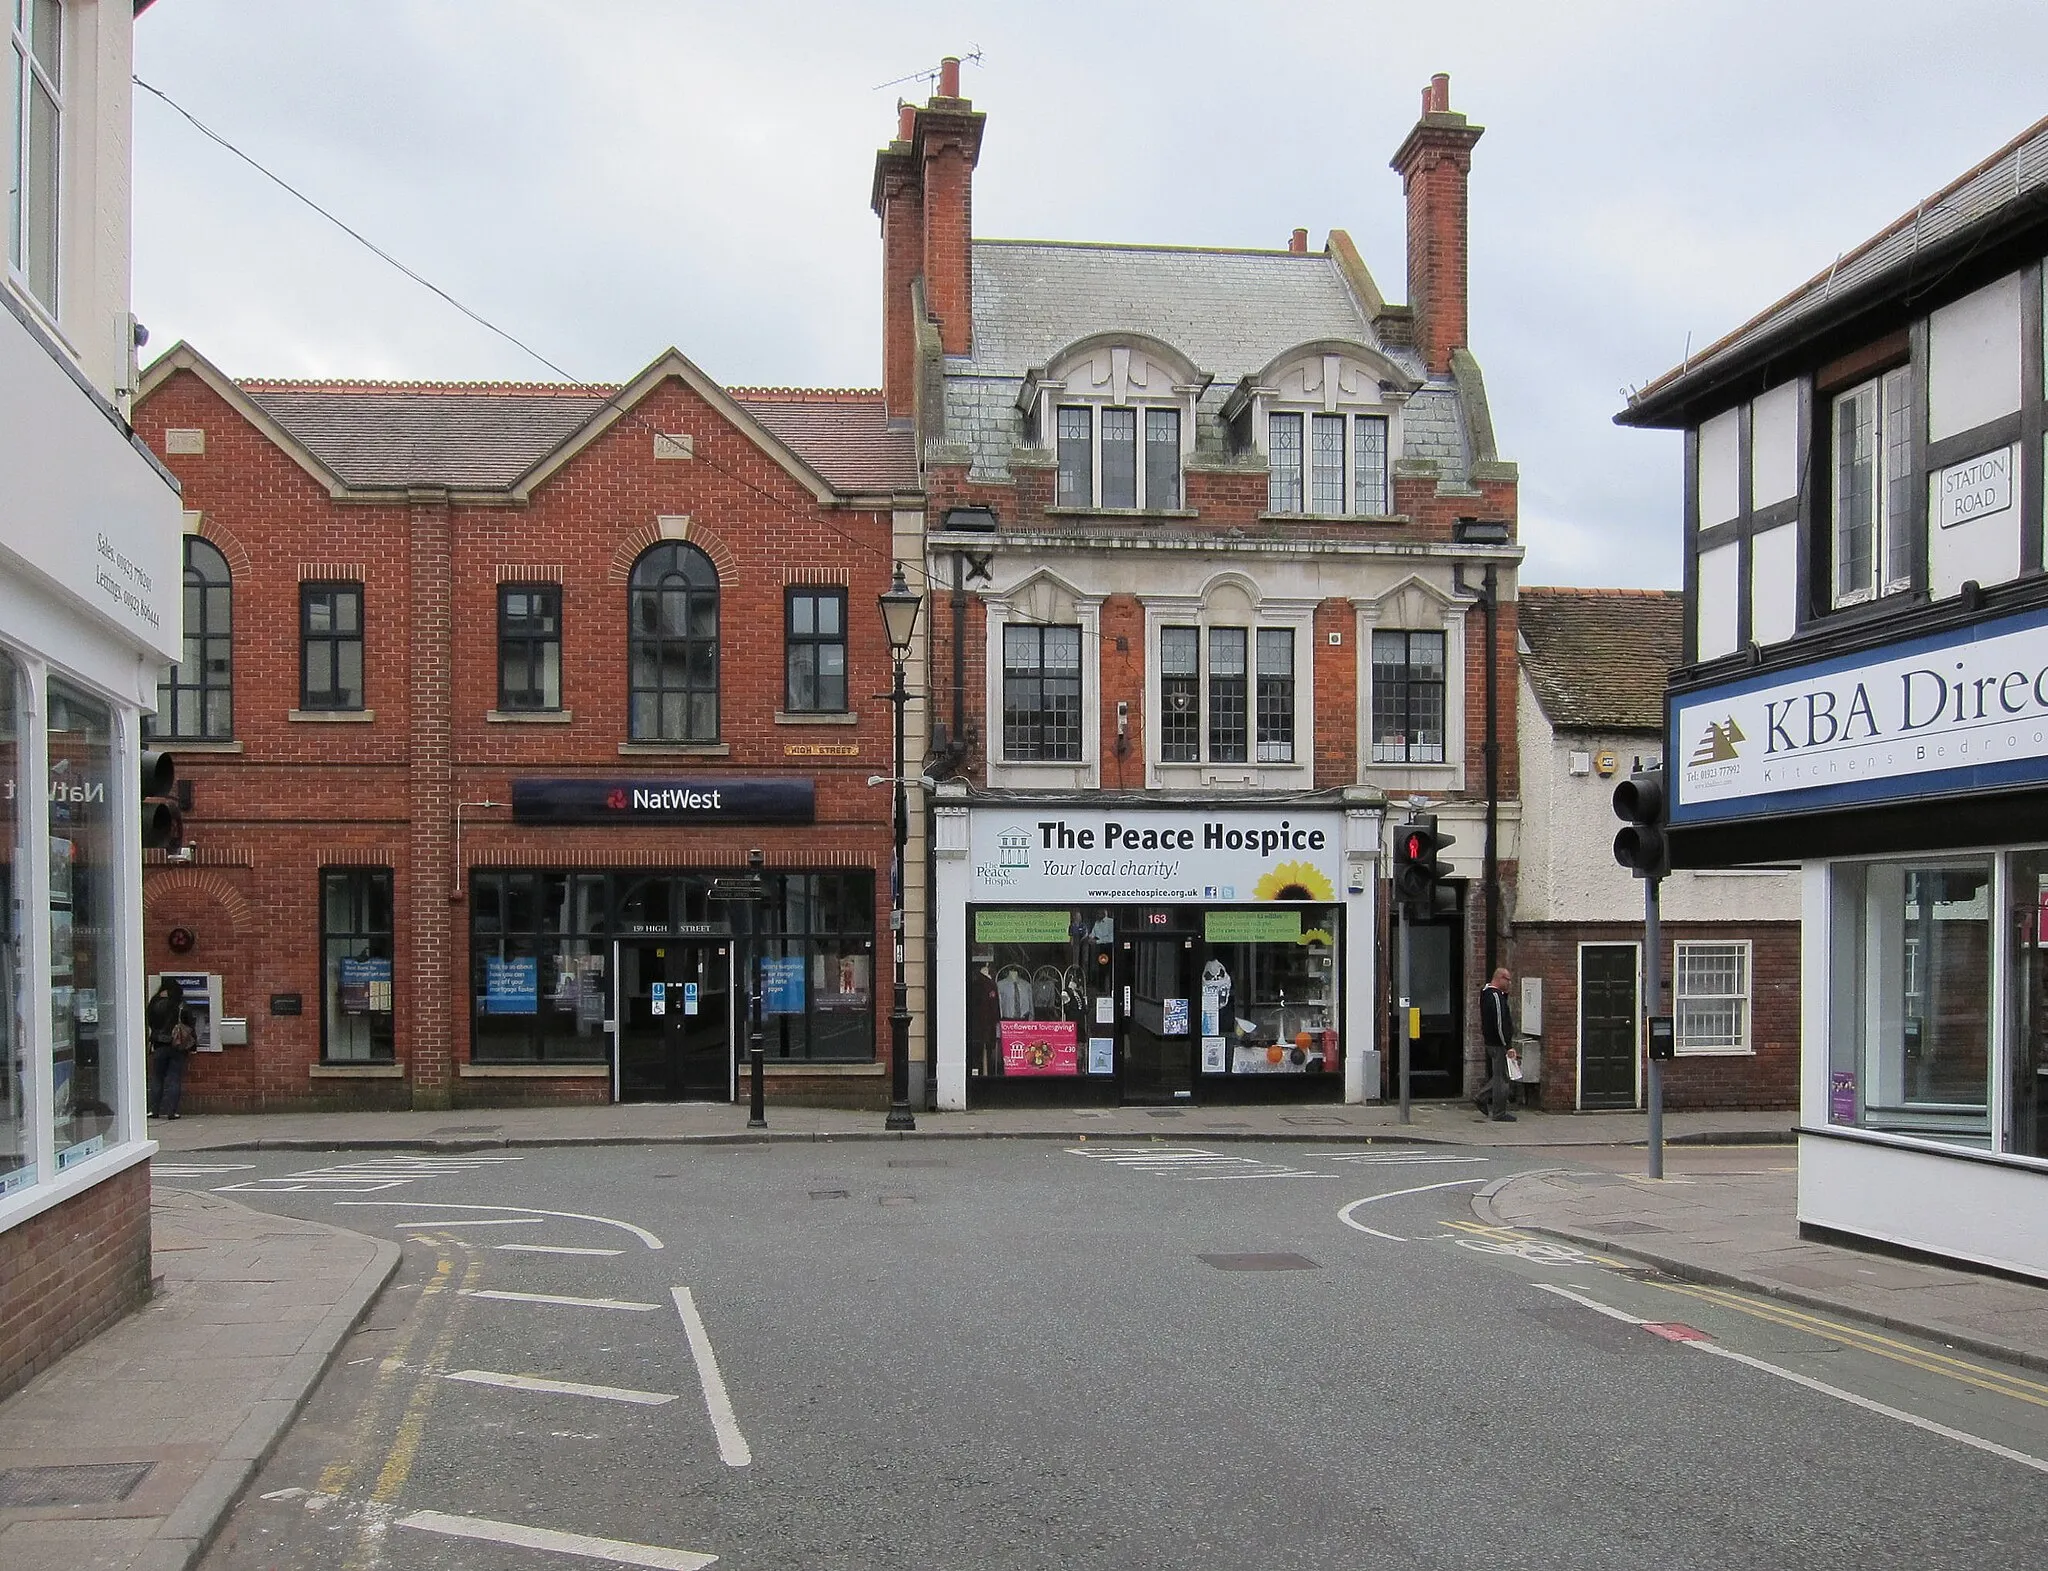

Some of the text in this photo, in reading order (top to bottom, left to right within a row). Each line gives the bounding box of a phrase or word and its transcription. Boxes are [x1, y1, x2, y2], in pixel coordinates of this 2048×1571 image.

[1946, 456, 2005, 493] STATION
[1954, 488, 1996, 516] ROAD
[1763, 682, 1882, 755] KBA
[792, 746, 812, 754] HIGH
[1764, 754, 1893, 782] Kitchens
[633, 789, 721, 809] NatWest
[1037, 820, 1325, 857] The Peace Hospice
[976, 867, 1010, 878] Peace
[1043, 859, 1179, 880] Your local charity!
[983, 877, 1018, 886] Hospice
[1088, 888, 1198, 899] www.peacehospice.org.uk
[1148, 914, 1167, 924] 163
